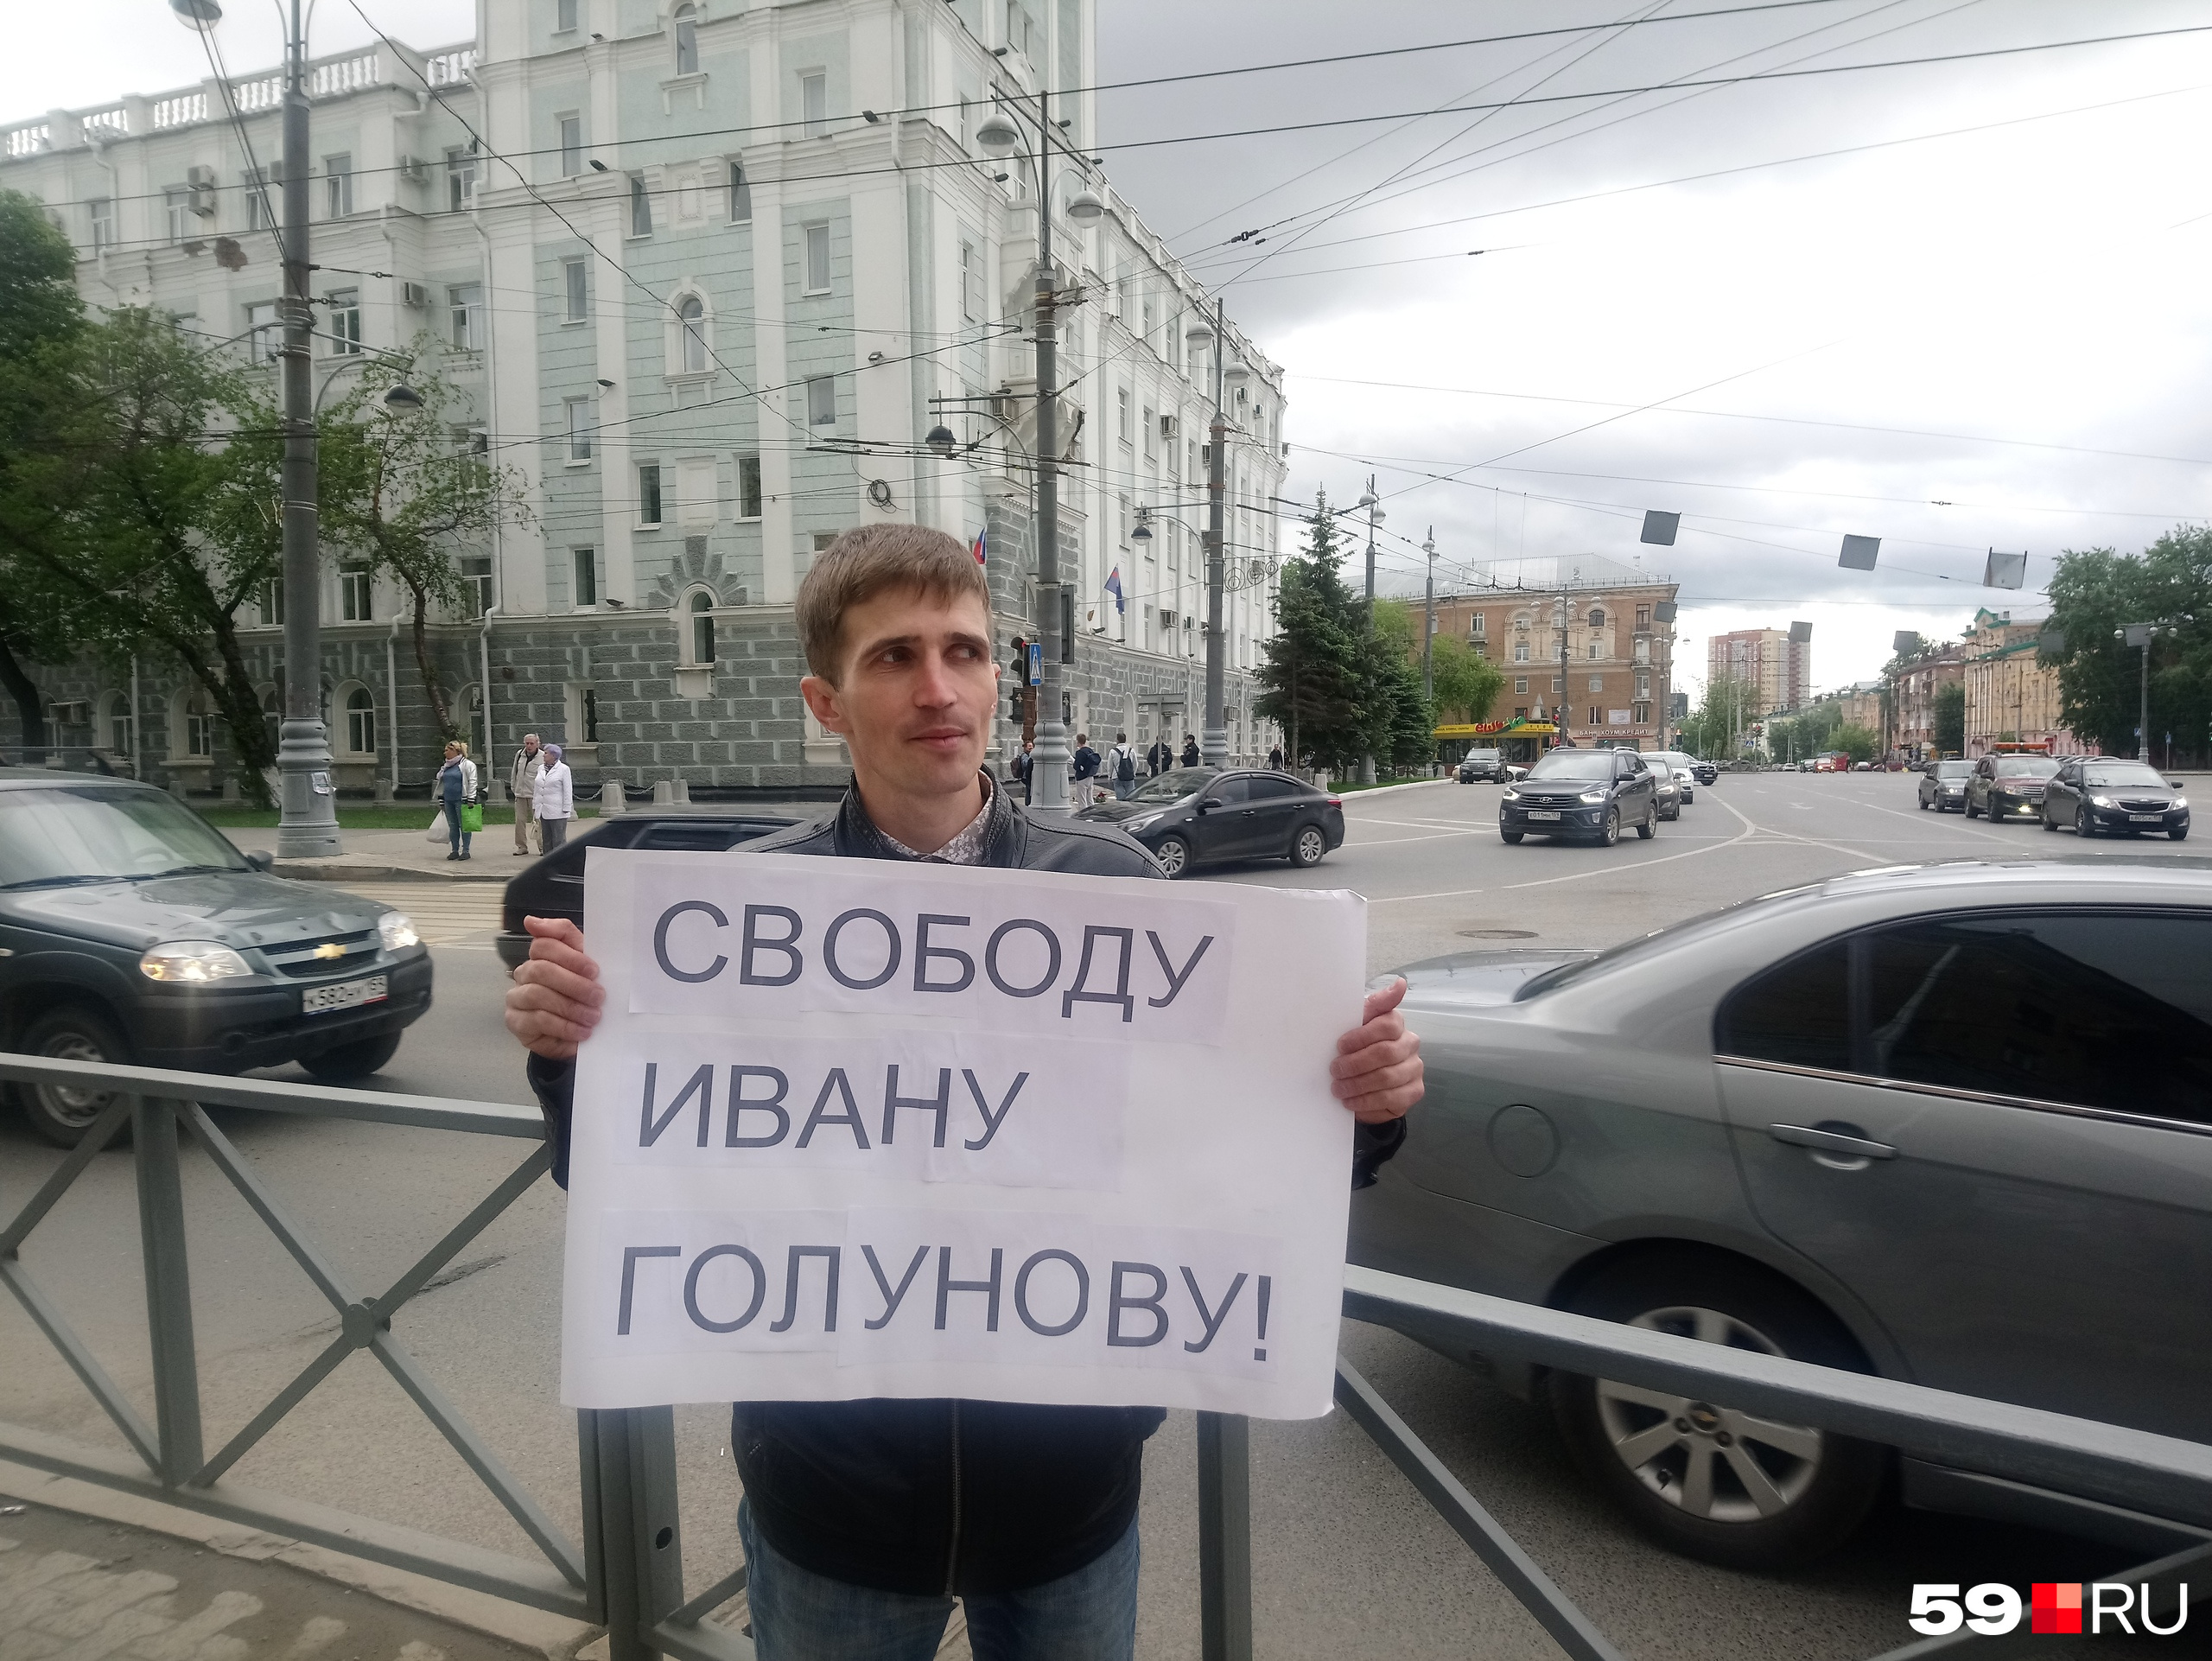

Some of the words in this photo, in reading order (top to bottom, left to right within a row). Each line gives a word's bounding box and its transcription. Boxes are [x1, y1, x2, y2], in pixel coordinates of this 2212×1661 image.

[654, 901, 1213, 1022] СВОБОДУ
[639, 1063, 1028, 1150] ИВАНУ
[618, 1244, 1271, 1361] ГОЛУНОВУ!
